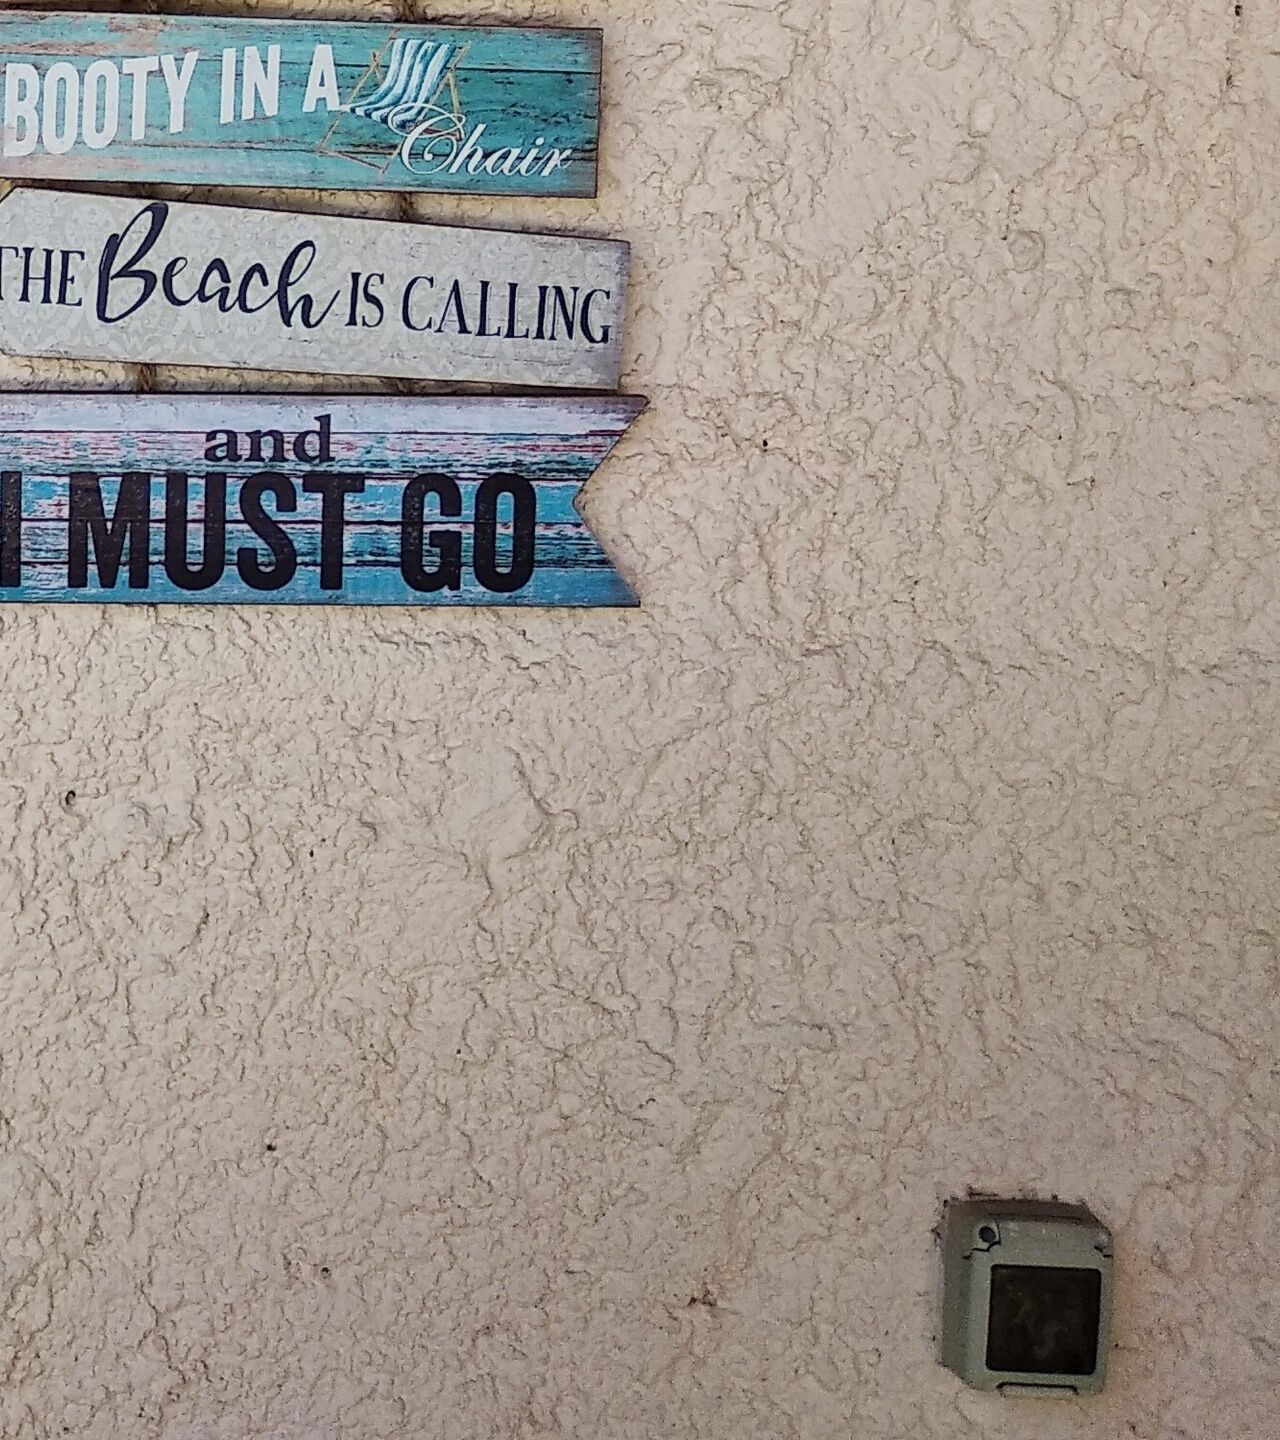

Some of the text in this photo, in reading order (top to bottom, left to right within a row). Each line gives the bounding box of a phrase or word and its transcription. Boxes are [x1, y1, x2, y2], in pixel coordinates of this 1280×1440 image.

[2, 43, 343, 158] BOOTY IN A
[388, 103, 578, 180] Chair
[95, 201, 343, 329] Beach
[344, 271, 386, 329] IS
[401, 275, 613, 345] CALLING
[203, 414, 337, 462] and
[67, 471, 366, 592] MUST
[400, 470, 537, 593] GO
